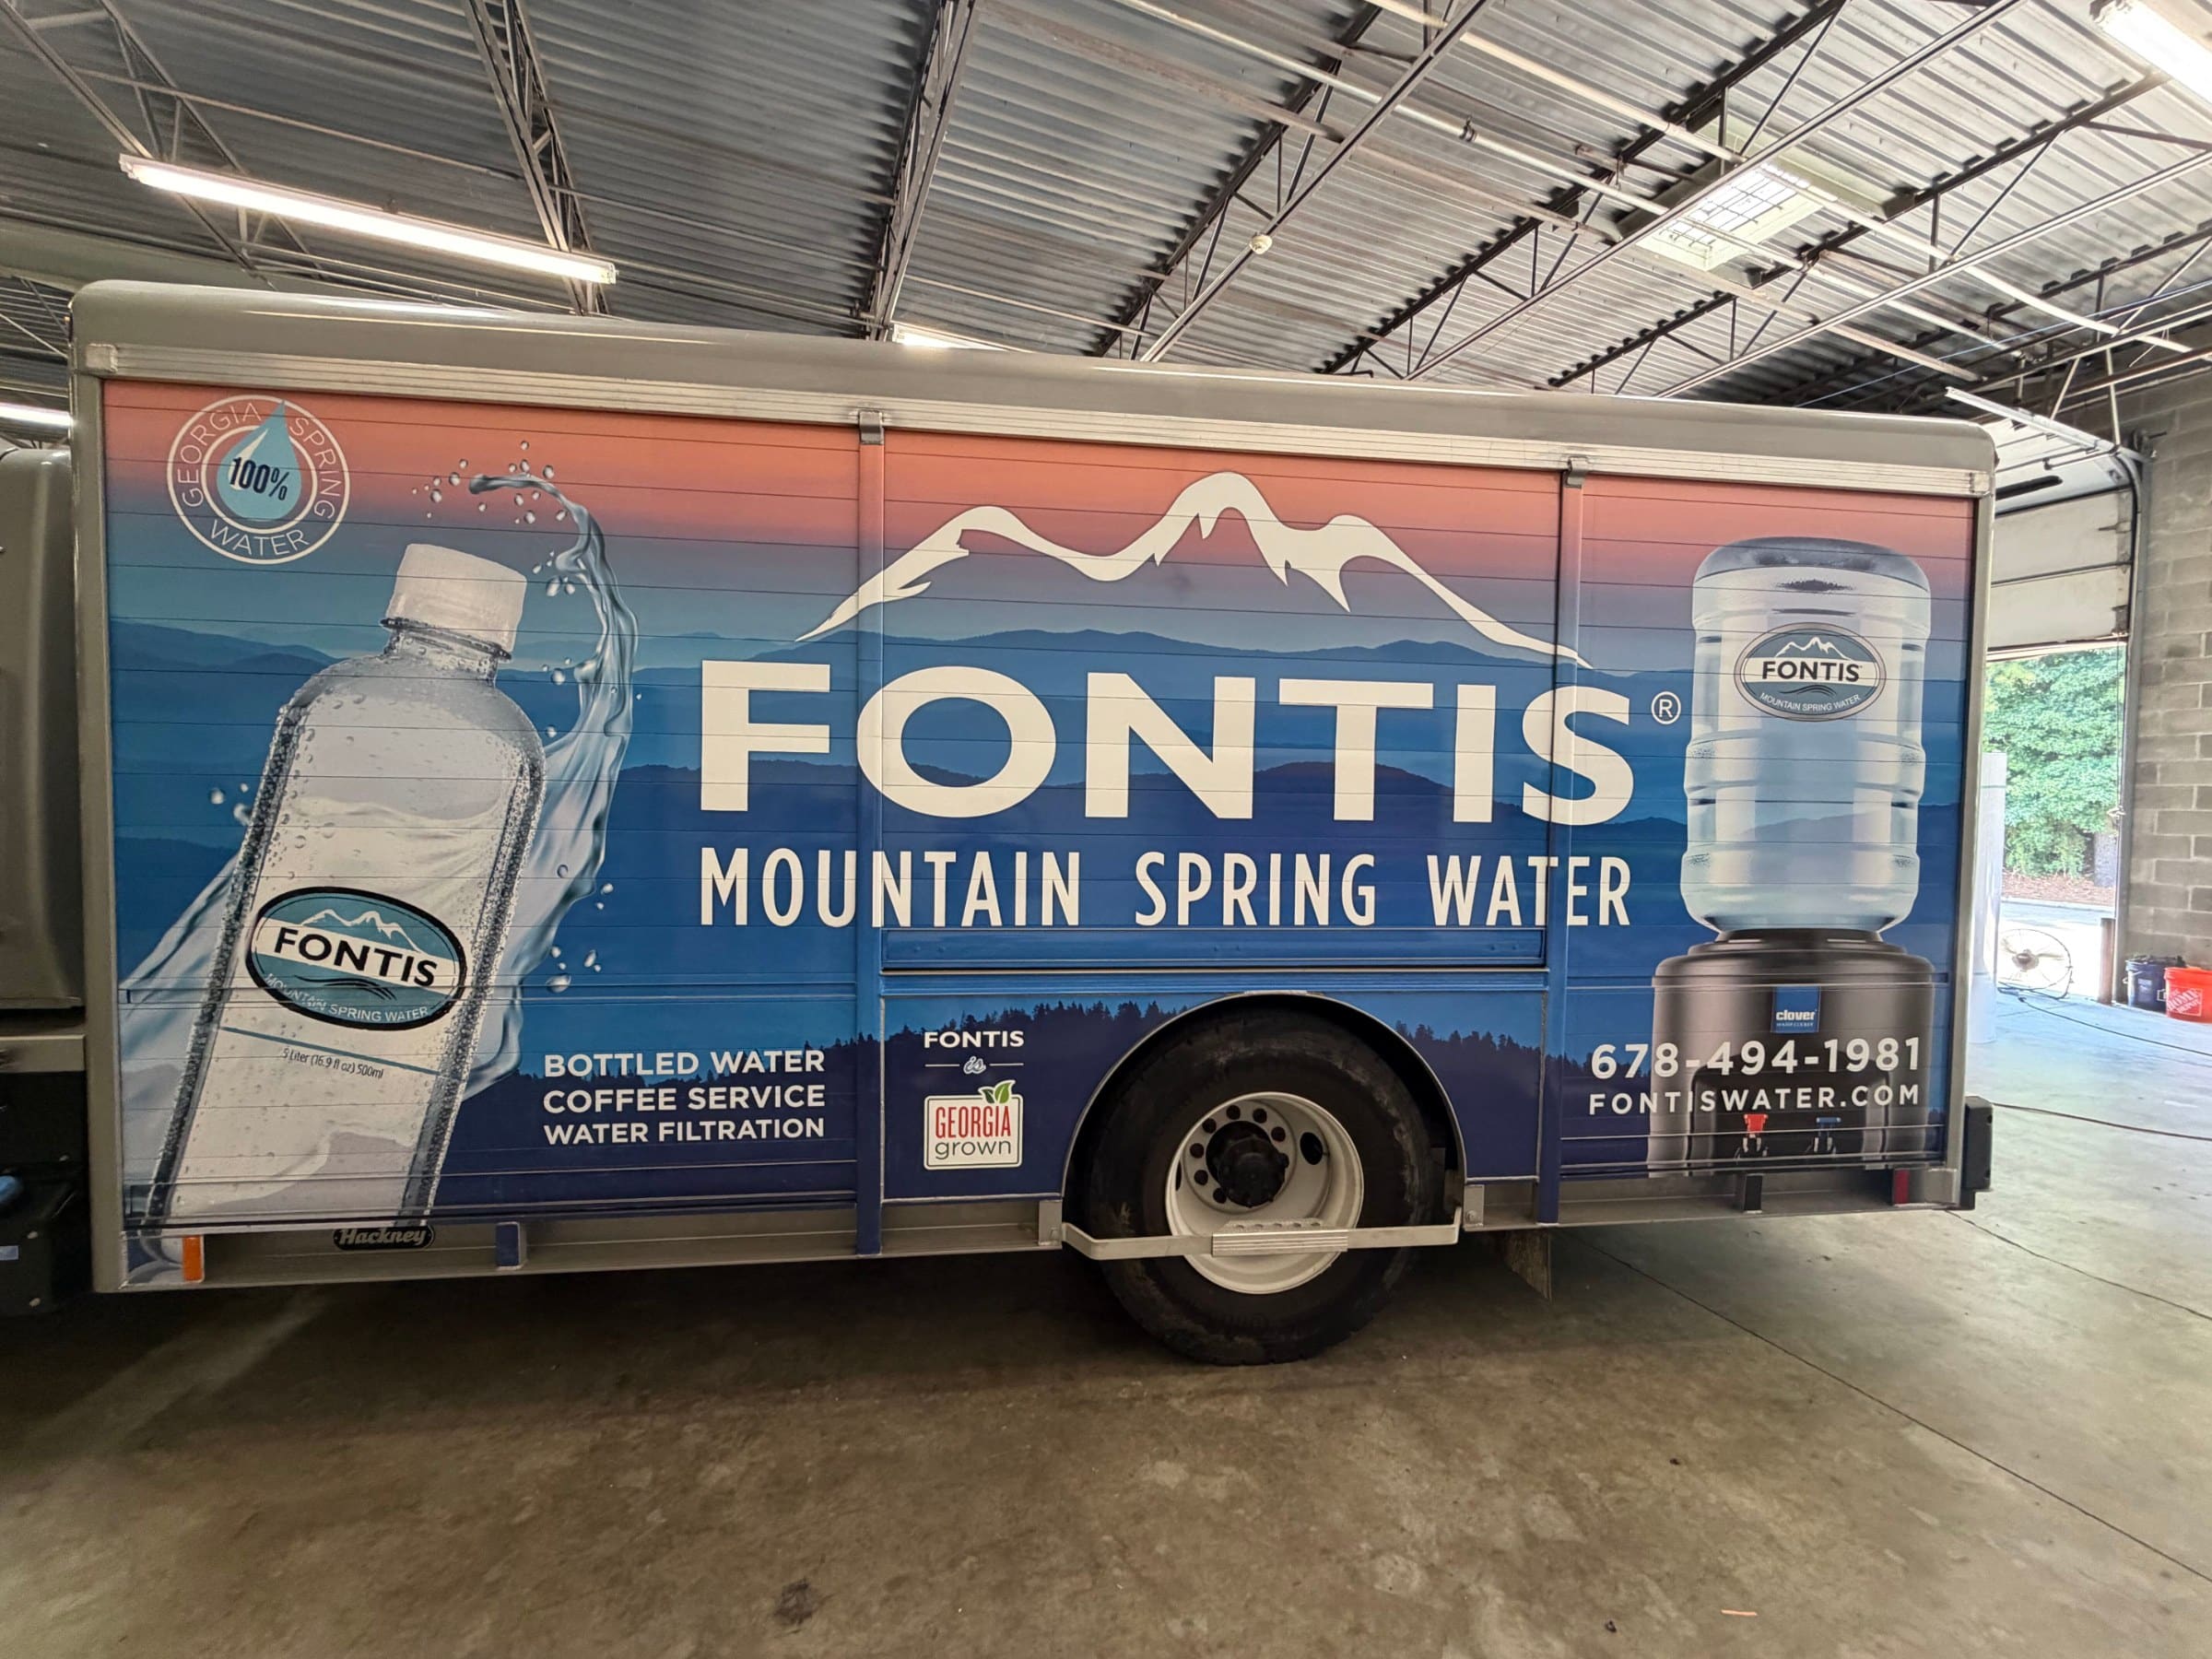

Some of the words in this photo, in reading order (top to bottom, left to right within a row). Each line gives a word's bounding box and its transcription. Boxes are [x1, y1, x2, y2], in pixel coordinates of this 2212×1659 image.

[177, 402, 262, 508] GEORGIA
[288, 418, 343, 519] SPRING
[229, 456, 289, 500] 100%
[209, 519, 310, 556] WATER
[1761, 661, 1860, 682] FONTIS
[1759, 692, 1801, 712] MOUNTAIN
[1802, 703, 1833, 712] SPRING
[1833, 693, 1861, 709] WATER
[701, 660, 1635, 826] FONTIS
[700, 846, 1081, 927] MOUNTAIN
[1135, 852, 1376, 927] SPRING
[1427, 854, 1630, 927] WATER
[274, 926, 438, 987] FONTIS
[328, 1004, 382, 1022] SPRING
[384, 1006, 429, 1023] WATER
[1775, 1009, 1815, 1021] clover
[924, 1030, 1025, 1048] FONTIS
[288, 1050, 310, 1065] Liter
[357, 1062, 384, 1079] 500ml
[544, 1052, 700, 1077] BOTTLED
[710, 1050, 826, 1074] WATER
[963, 1055, 987, 1075] is
[1591, 1037, 1920, 1079] 678-494-1981
[543, 1088, 677, 1113] COFFEE
[688, 1084, 826, 1110] SERVICE
[1589, 1084, 1920, 1115] FONTISWATER.COM
[543, 1123, 649, 1145] WATER
[658, 1117, 825, 1142] FILTRATION
[935, 1105, 1012, 1139] GEORGIA
[935, 1139, 1012, 1160] grown
[339, 1227, 427, 1246] Hackney
